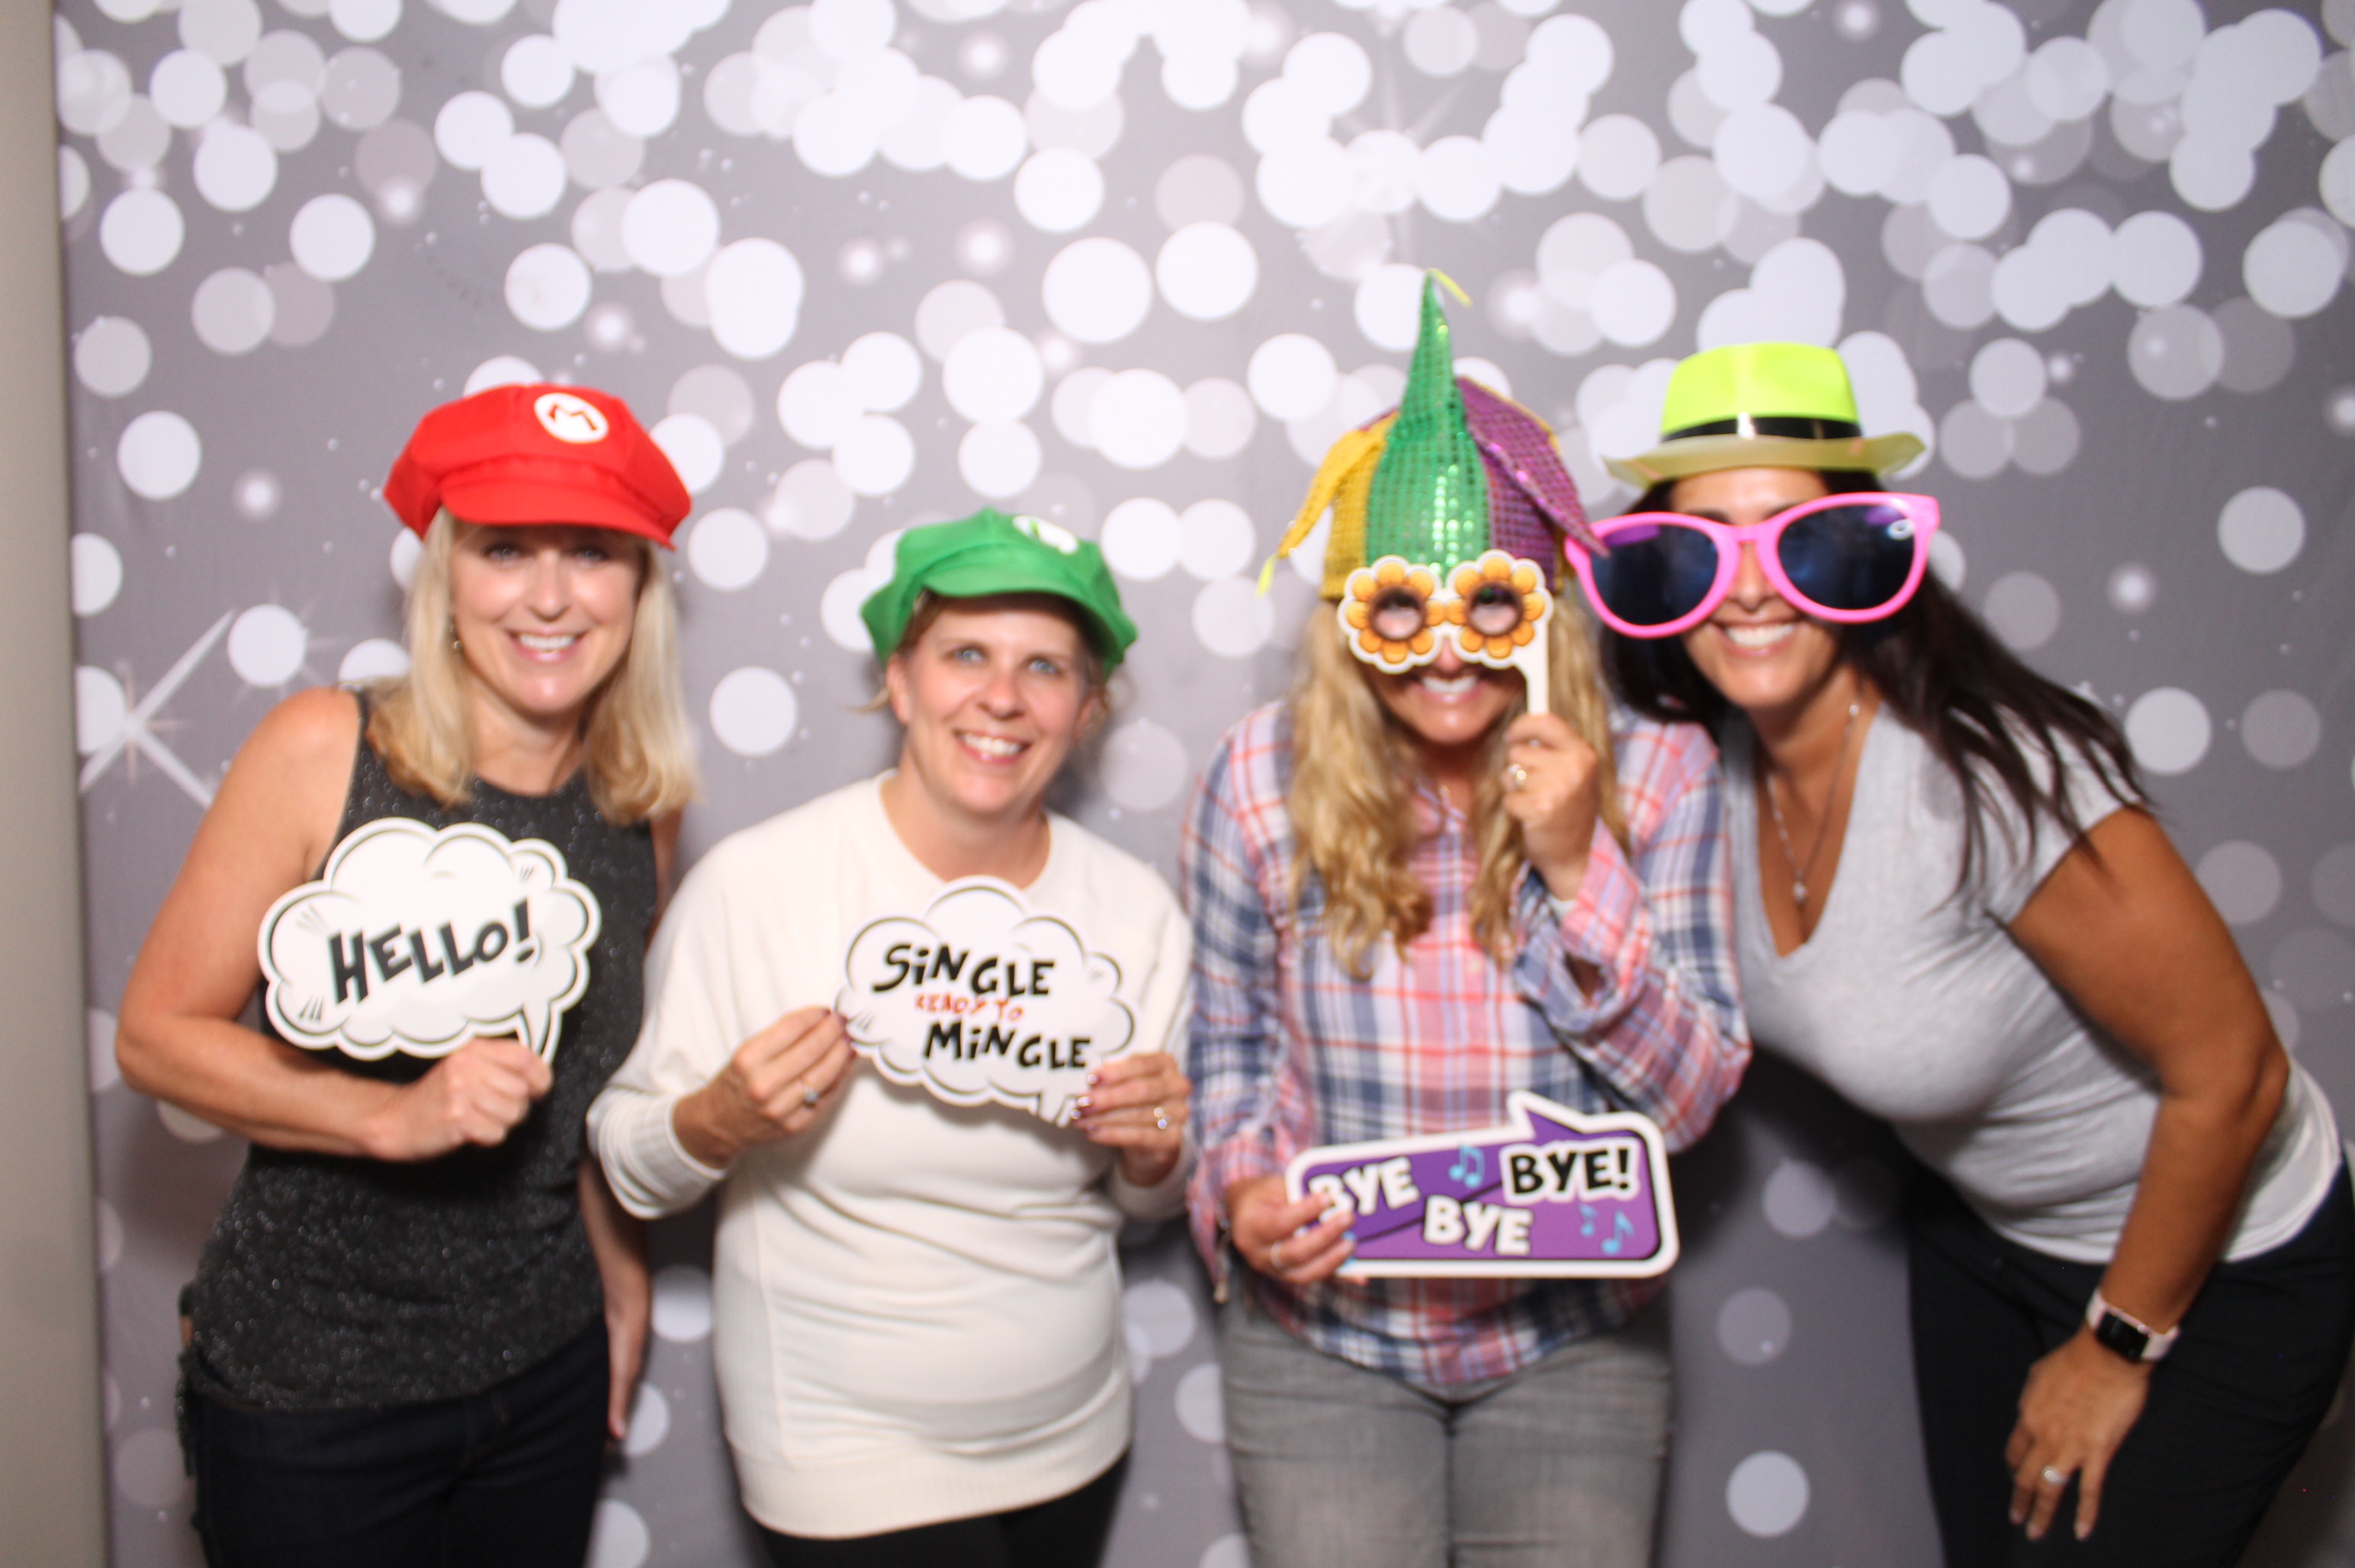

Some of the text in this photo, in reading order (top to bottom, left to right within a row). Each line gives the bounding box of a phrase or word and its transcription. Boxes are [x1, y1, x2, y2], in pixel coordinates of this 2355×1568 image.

[328, 896, 536, 1006] HELLO!
[914, 991, 1026, 1023] READY TO
[1307, 1155, 1421, 1225] BYE
[1508, 1145, 1633, 1197] BYE!
[1422, 1194, 1534, 1256] BYE
